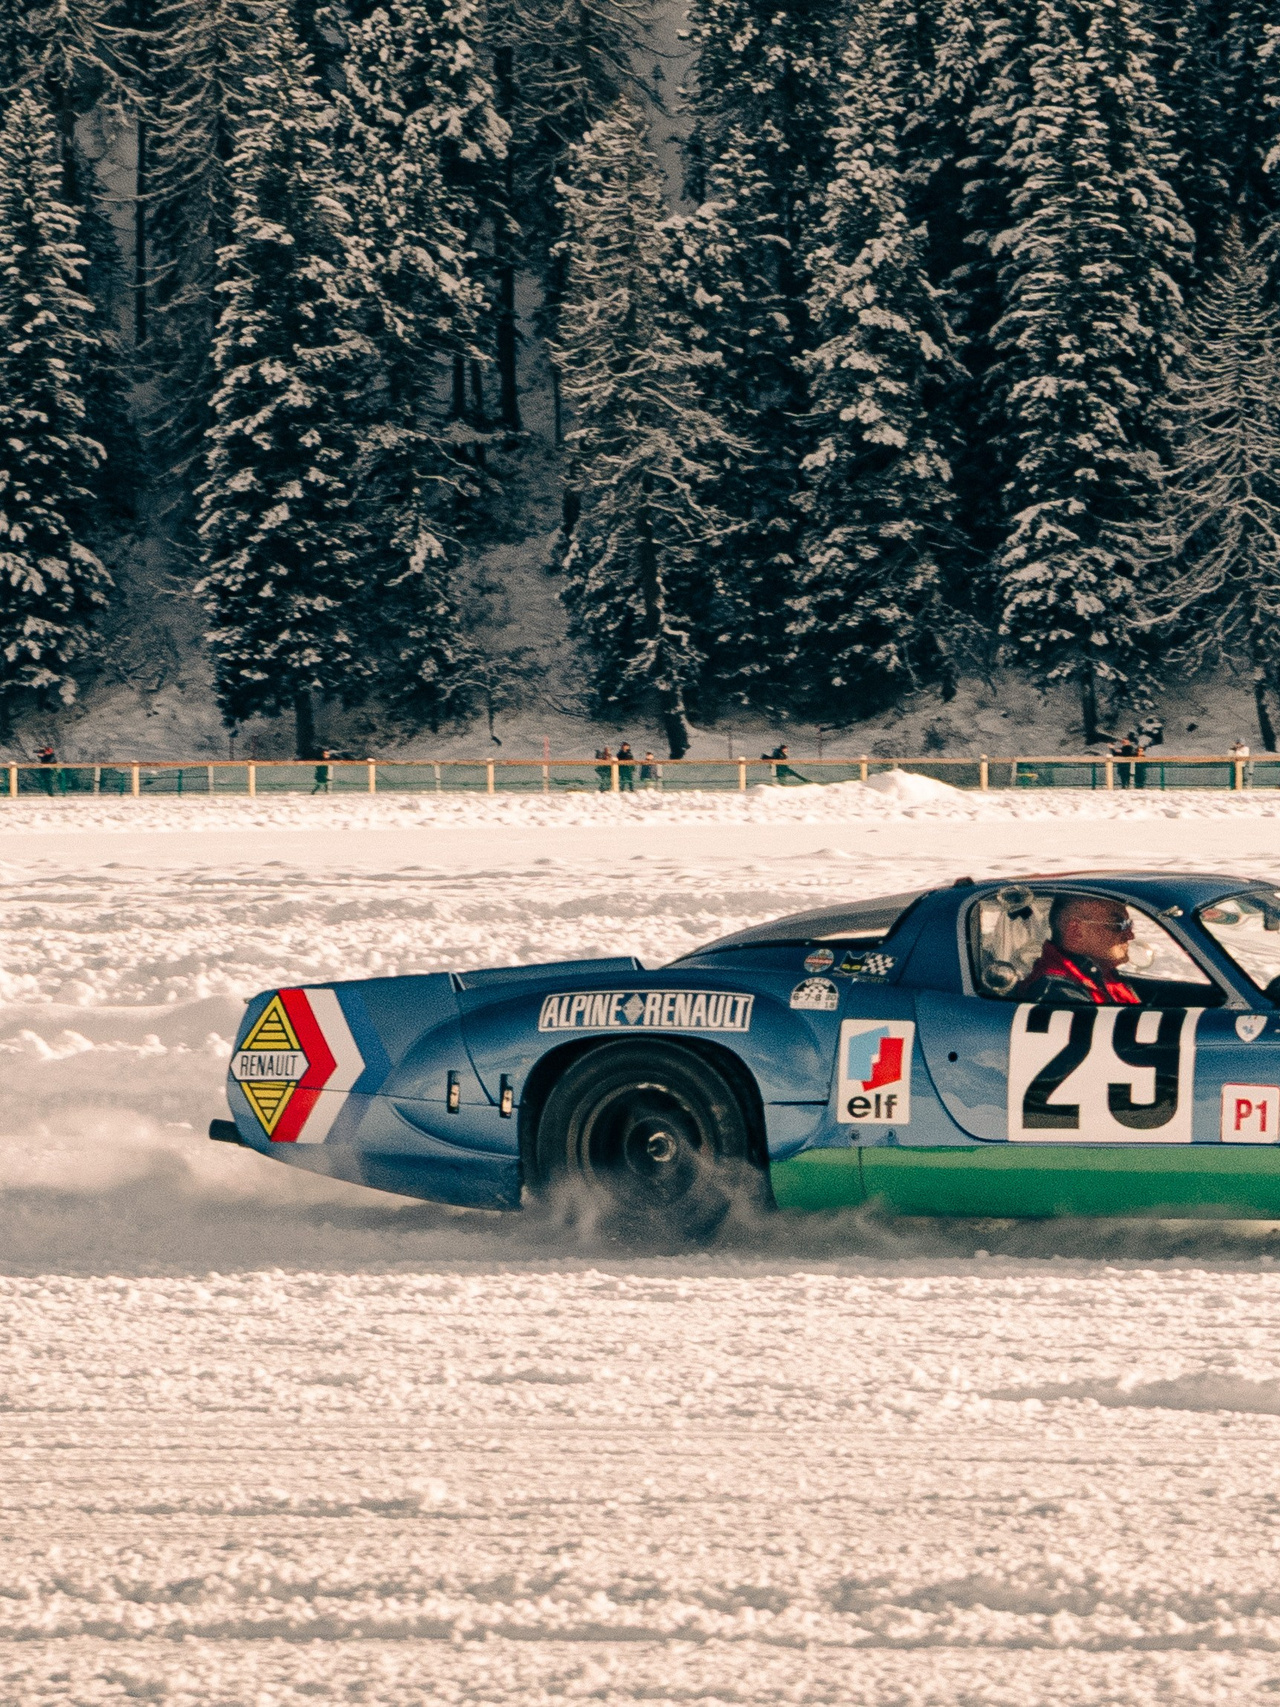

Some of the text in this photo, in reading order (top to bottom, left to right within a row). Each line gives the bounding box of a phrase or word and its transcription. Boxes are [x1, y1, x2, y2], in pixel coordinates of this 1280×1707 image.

[543, 993, 750, 1027] ALPINE RENAULT
[240, 1055, 298, 1076] RENAULT
[1022, 1006, 1188, 1130] 29
[847, 1093, 897, 1118] elf
[1234, 1098, 1267, 1132] P1
